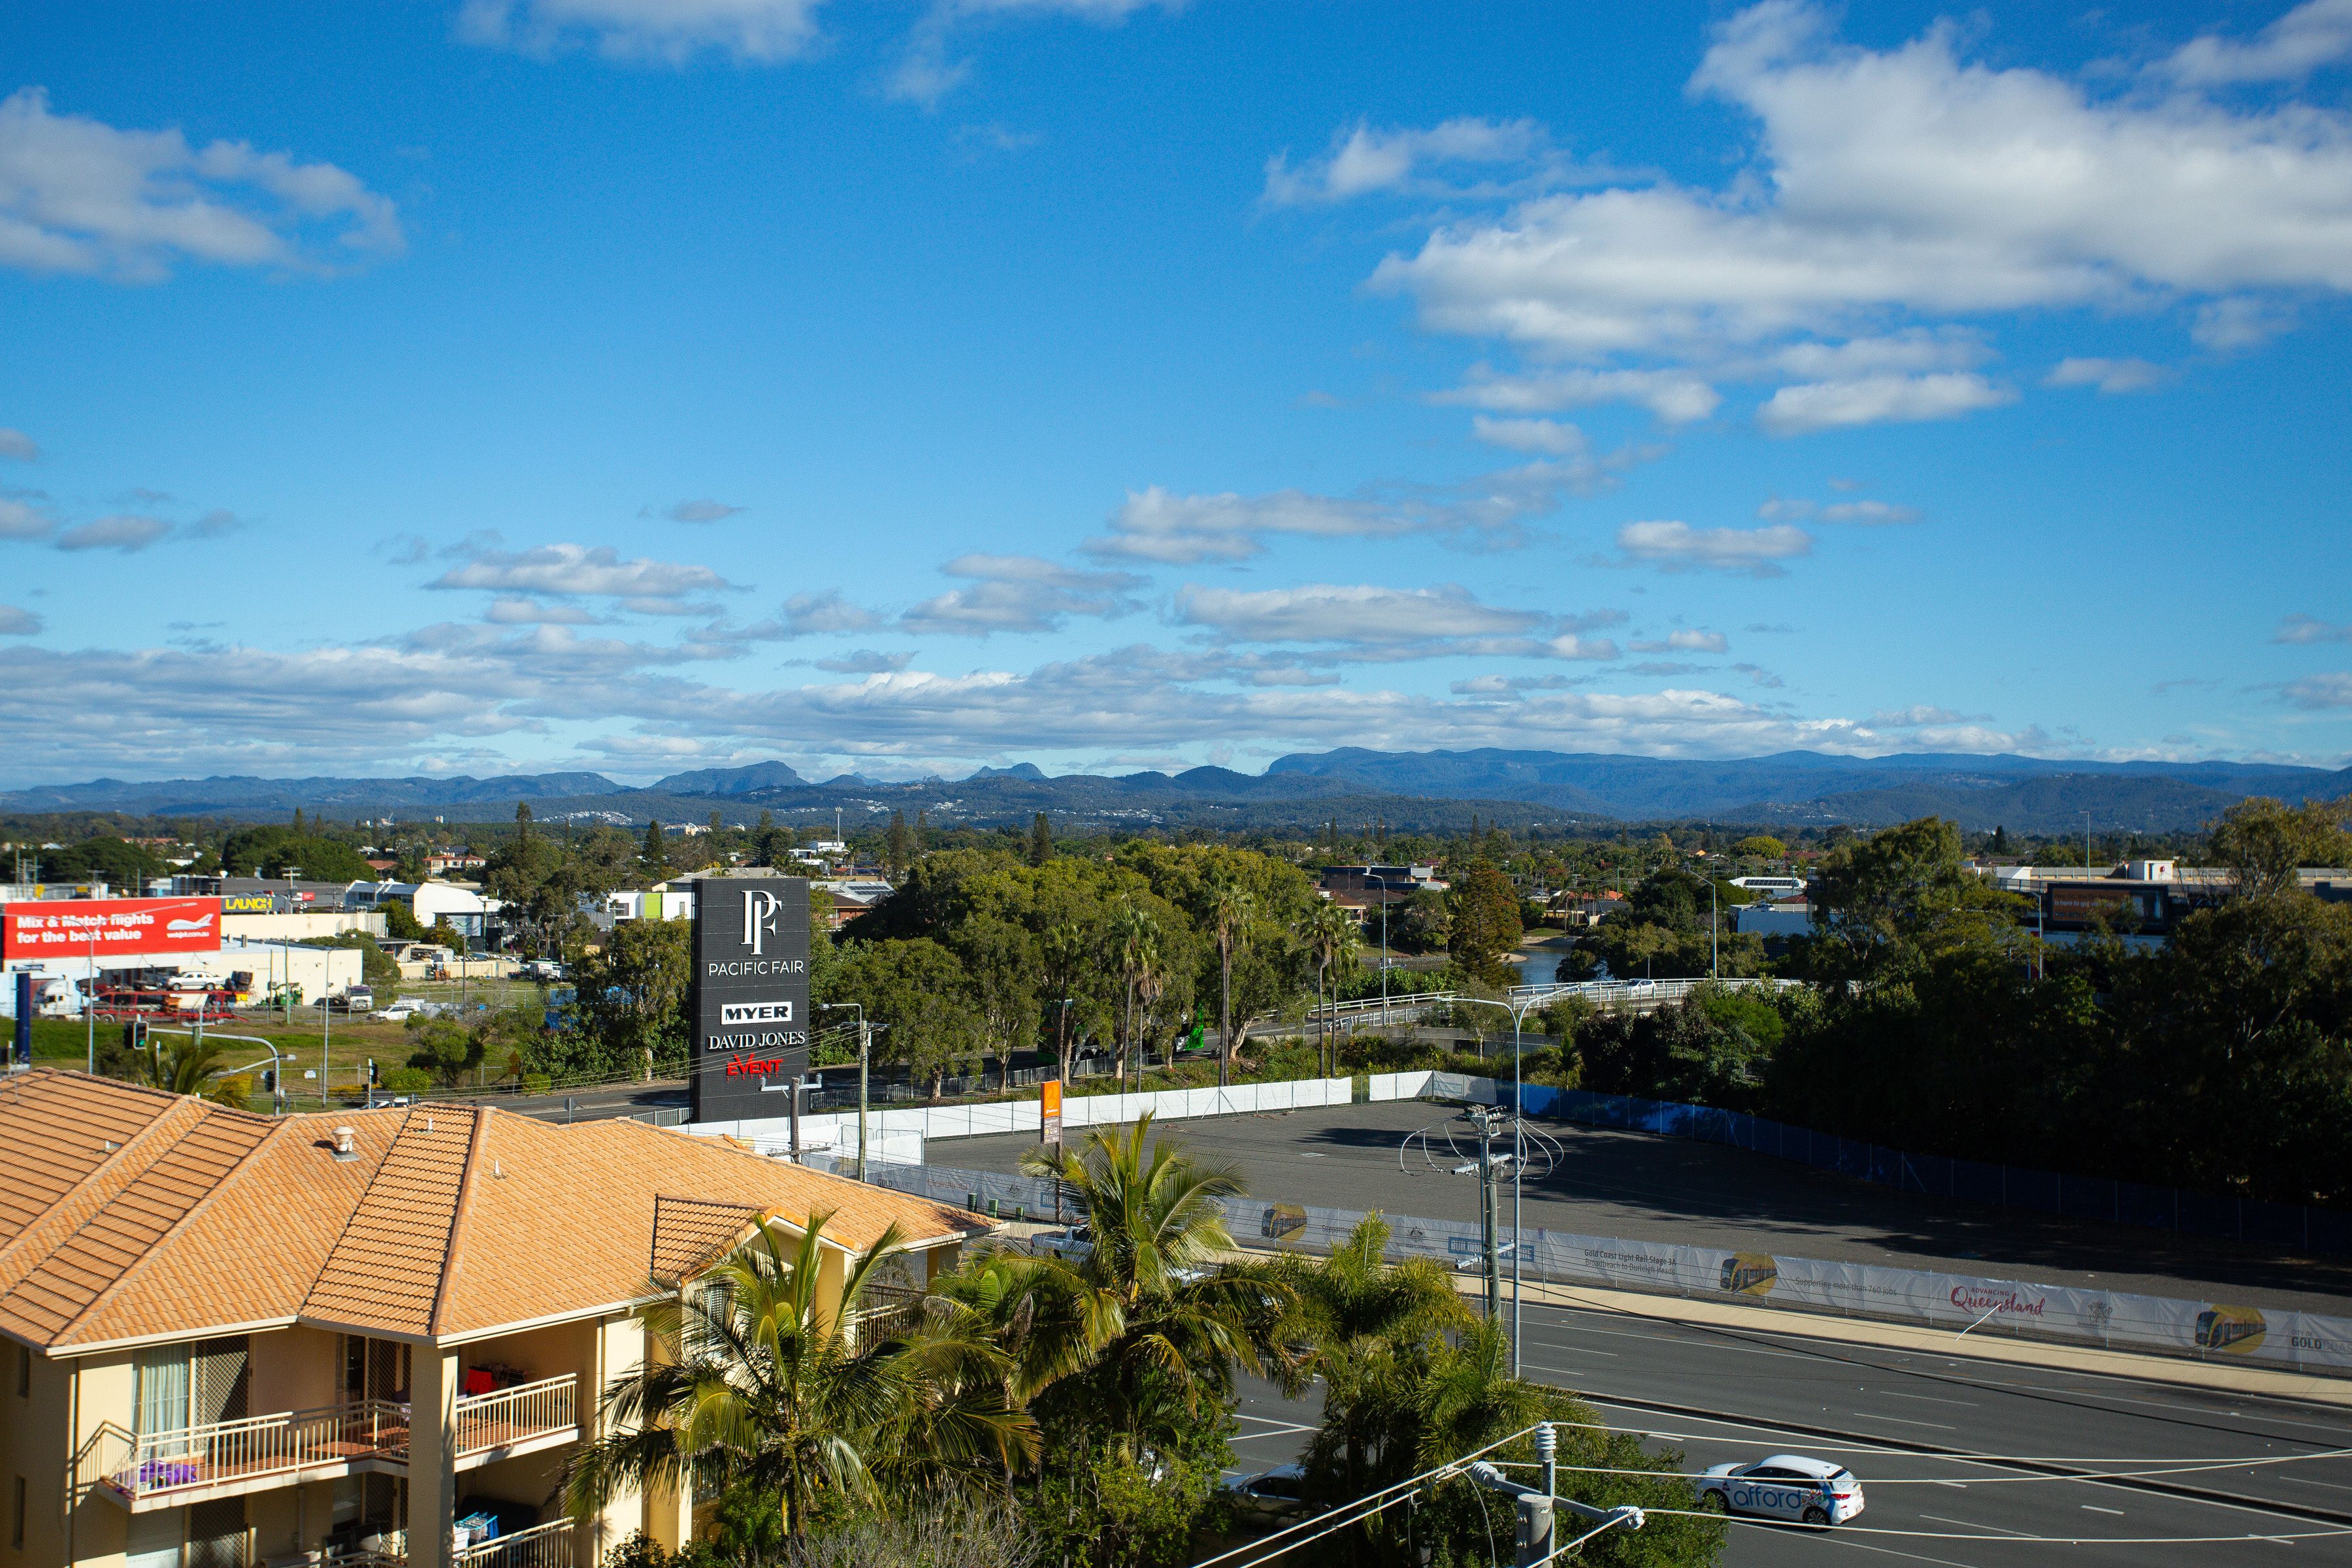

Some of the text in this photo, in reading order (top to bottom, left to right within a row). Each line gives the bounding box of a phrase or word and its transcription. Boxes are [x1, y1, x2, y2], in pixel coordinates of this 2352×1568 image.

[225, 897, 272, 910] LAUNCH
[17, 913, 154, 928] Mix & Match flights
[16, 928, 142, 943] for the best value
[708, 960, 804, 976] PACIFIC FAIR
[725, 1006, 788, 1020] MYER
[708, 1032, 805, 1049] DAVID JONES
[727, 1053, 784, 1076] EVENT
[1584, 1249, 1598, 1257] Gold
[1600, 1250, 1616, 1260] Coast
[1618, 1252, 1633, 1262] Light
[1649, 1256, 1667, 1266] Stage
[1585, 1259, 1620, 1269] Broadbeach
[1629, 1264, 1655, 1274] Burleigh
[1795, 1277, 1831, 1290] Supporting
[1851, 1283, 1867, 1292] than
[1882, 1288, 1897, 1296] jobs
[1970, 1287, 2010, 1297] ADVANCING
[1950, 1286, 2045, 1317] Queensland
[2291, 1337, 2322, 1349] GOLD
[1733, 1486, 1802, 1509] afford
